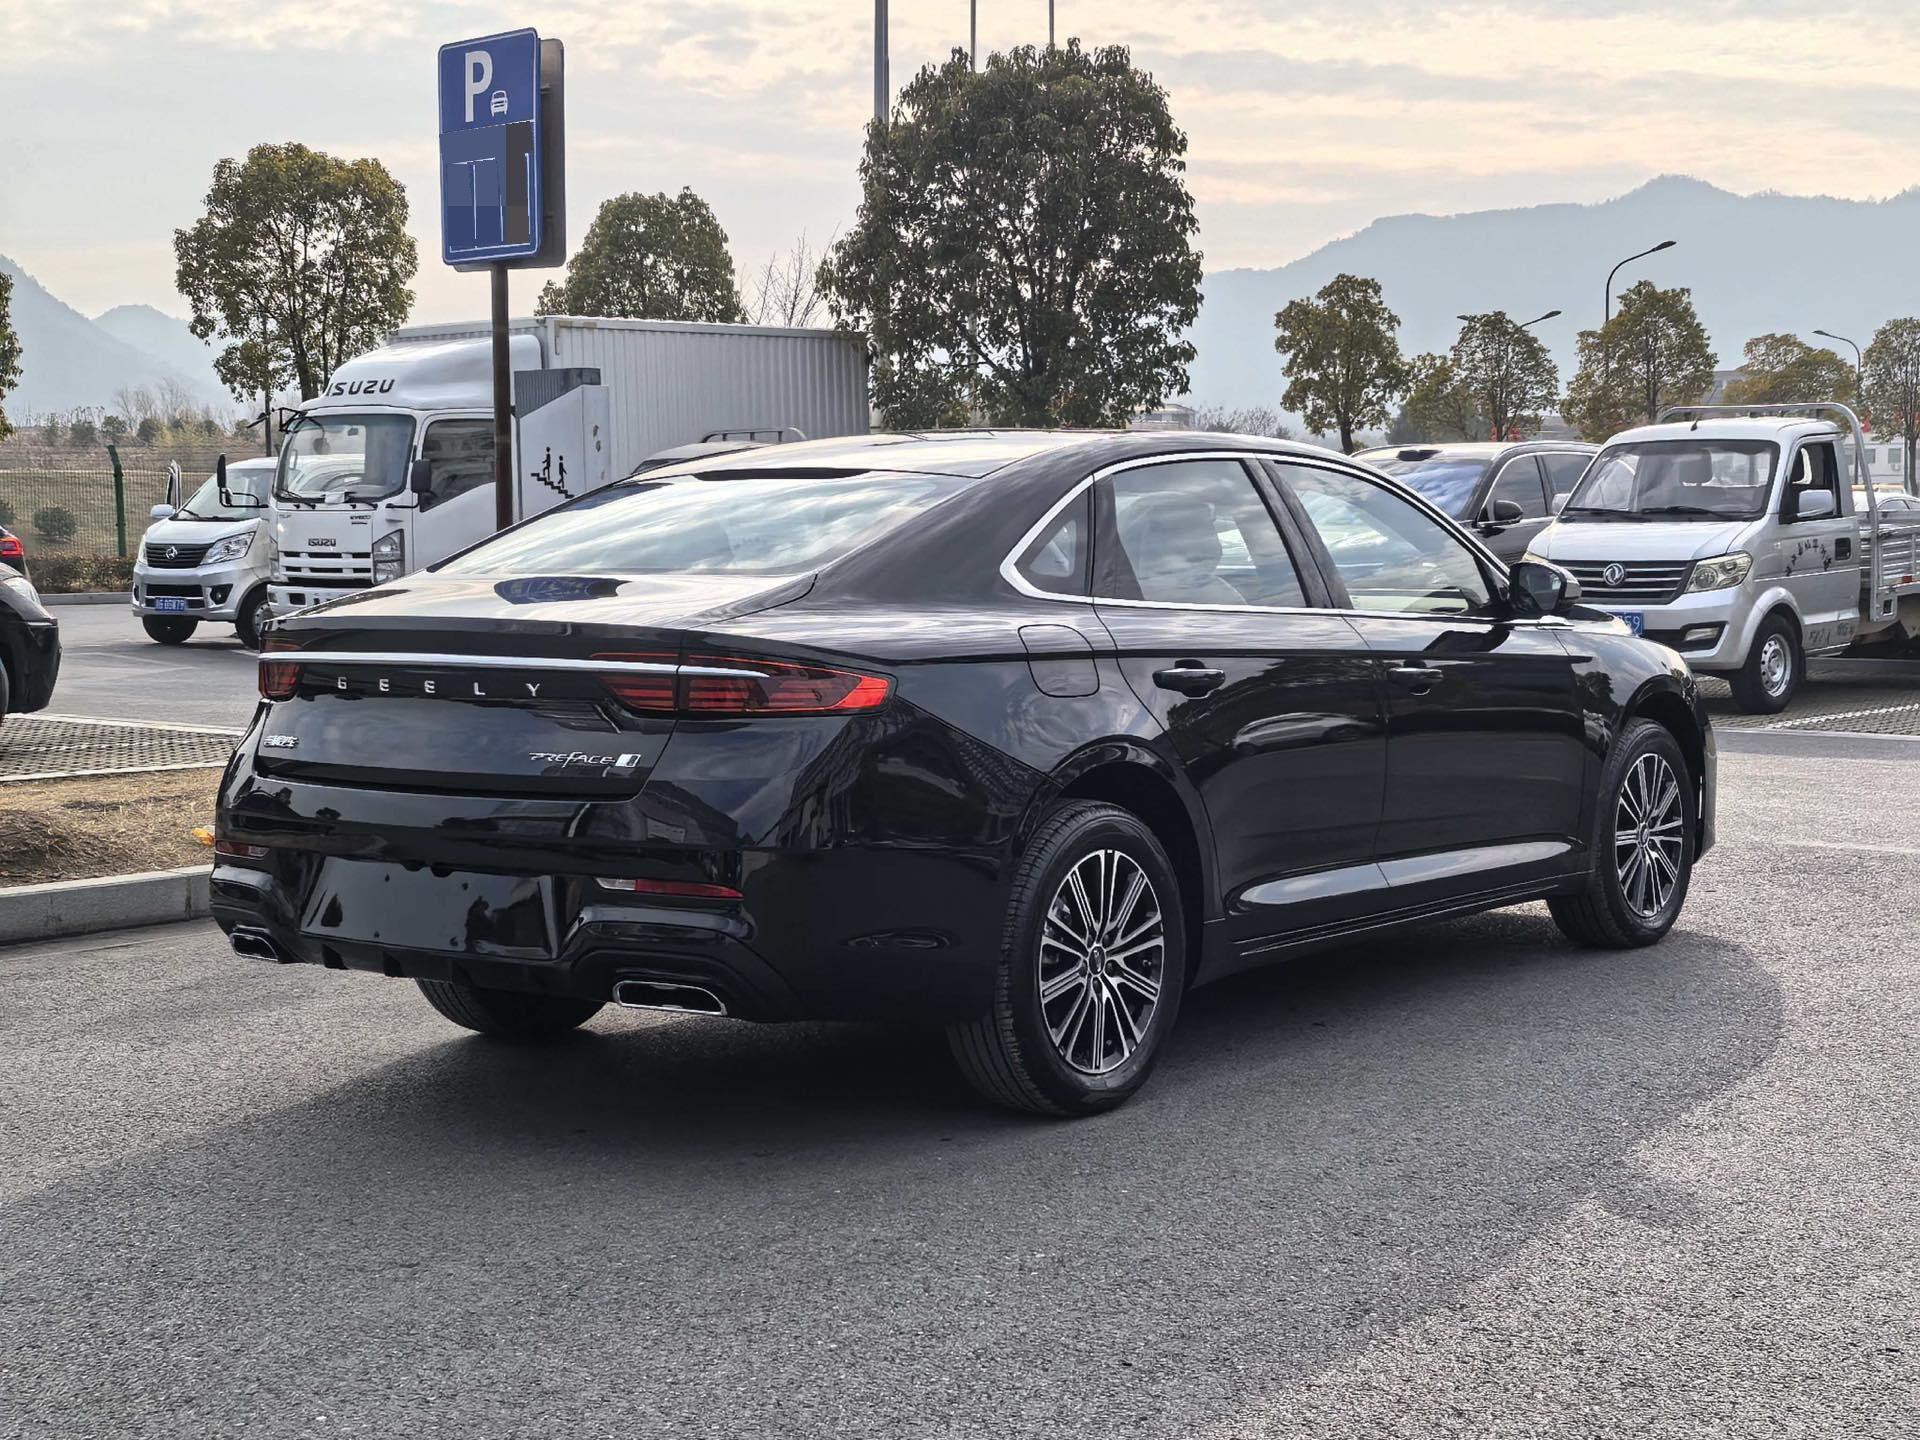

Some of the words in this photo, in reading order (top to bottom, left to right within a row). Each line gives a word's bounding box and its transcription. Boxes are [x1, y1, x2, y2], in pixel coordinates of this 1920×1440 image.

[465, 50, 493, 122] P
[325, 379, 396, 396] ISUZU
[308, 538, 337, 547] ISUZU
[337, 676, 541, 697] GEELY
